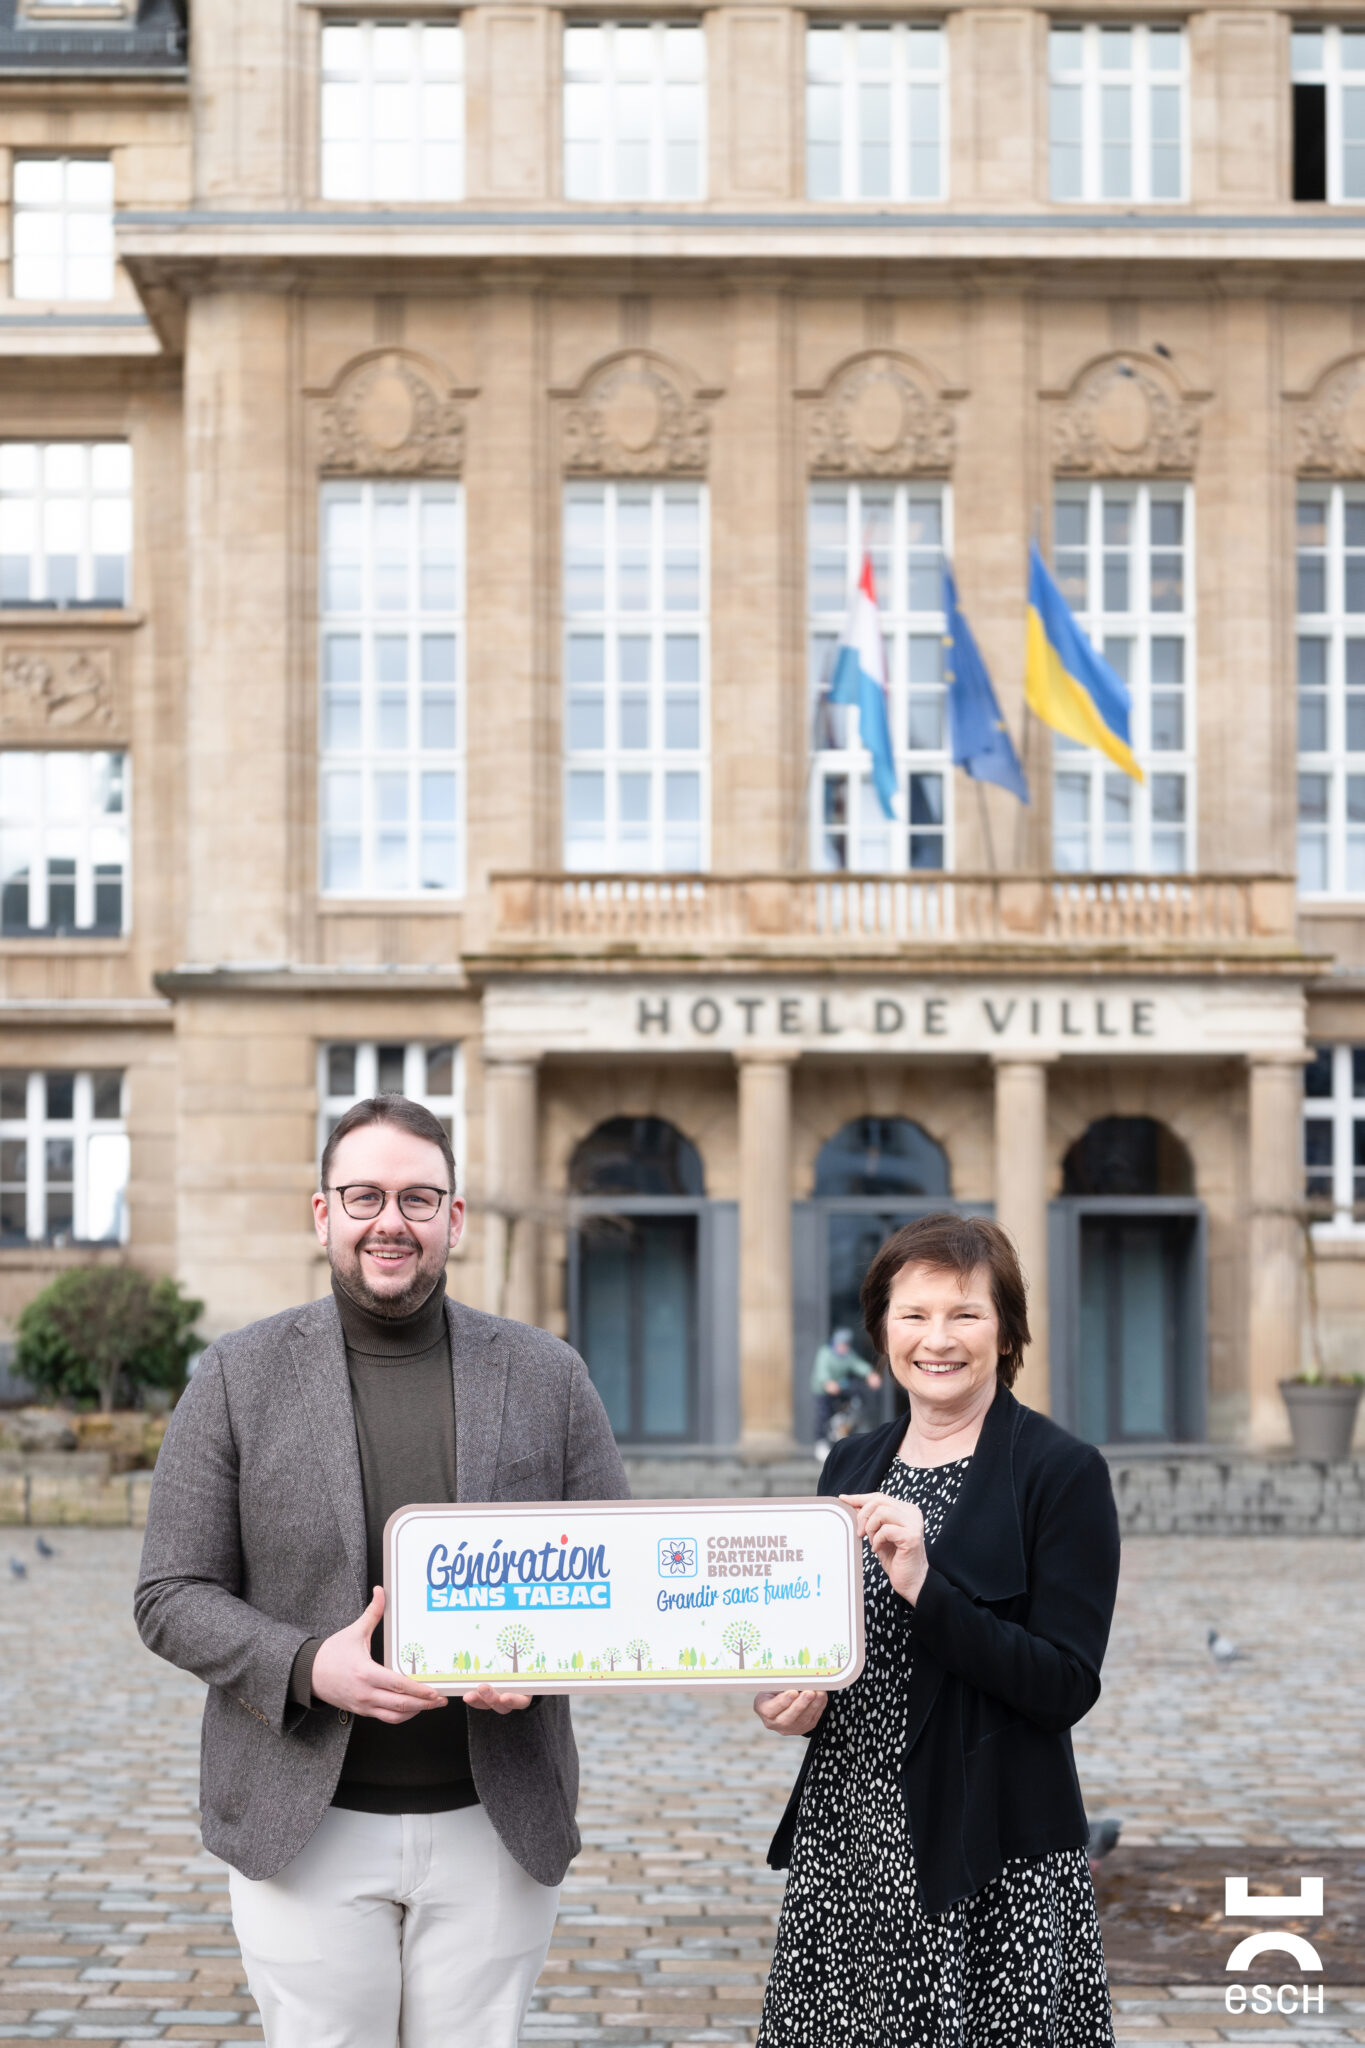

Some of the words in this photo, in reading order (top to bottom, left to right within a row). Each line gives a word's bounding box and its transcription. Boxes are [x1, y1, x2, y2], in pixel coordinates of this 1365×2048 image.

[637, 998, 843, 1035] HOTEL
[874, 998, 949, 1035] DE
[982, 998, 1156, 1036] VILLE
[706, 1535, 788, 1549] COMMUNE
[426, 1534, 611, 1591] Génération
[707, 1549, 804, 1563] PARTENAIRE
[707, 1563, 773, 1578] BRONZE
[431, 1587, 506, 1608] SANS
[513, 1584, 608, 1606] TABAC
[656, 1584, 719, 1612] Grandir
[722, 1585, 759, 1606] sans
[763, 1576, 811, 1605] fumée
